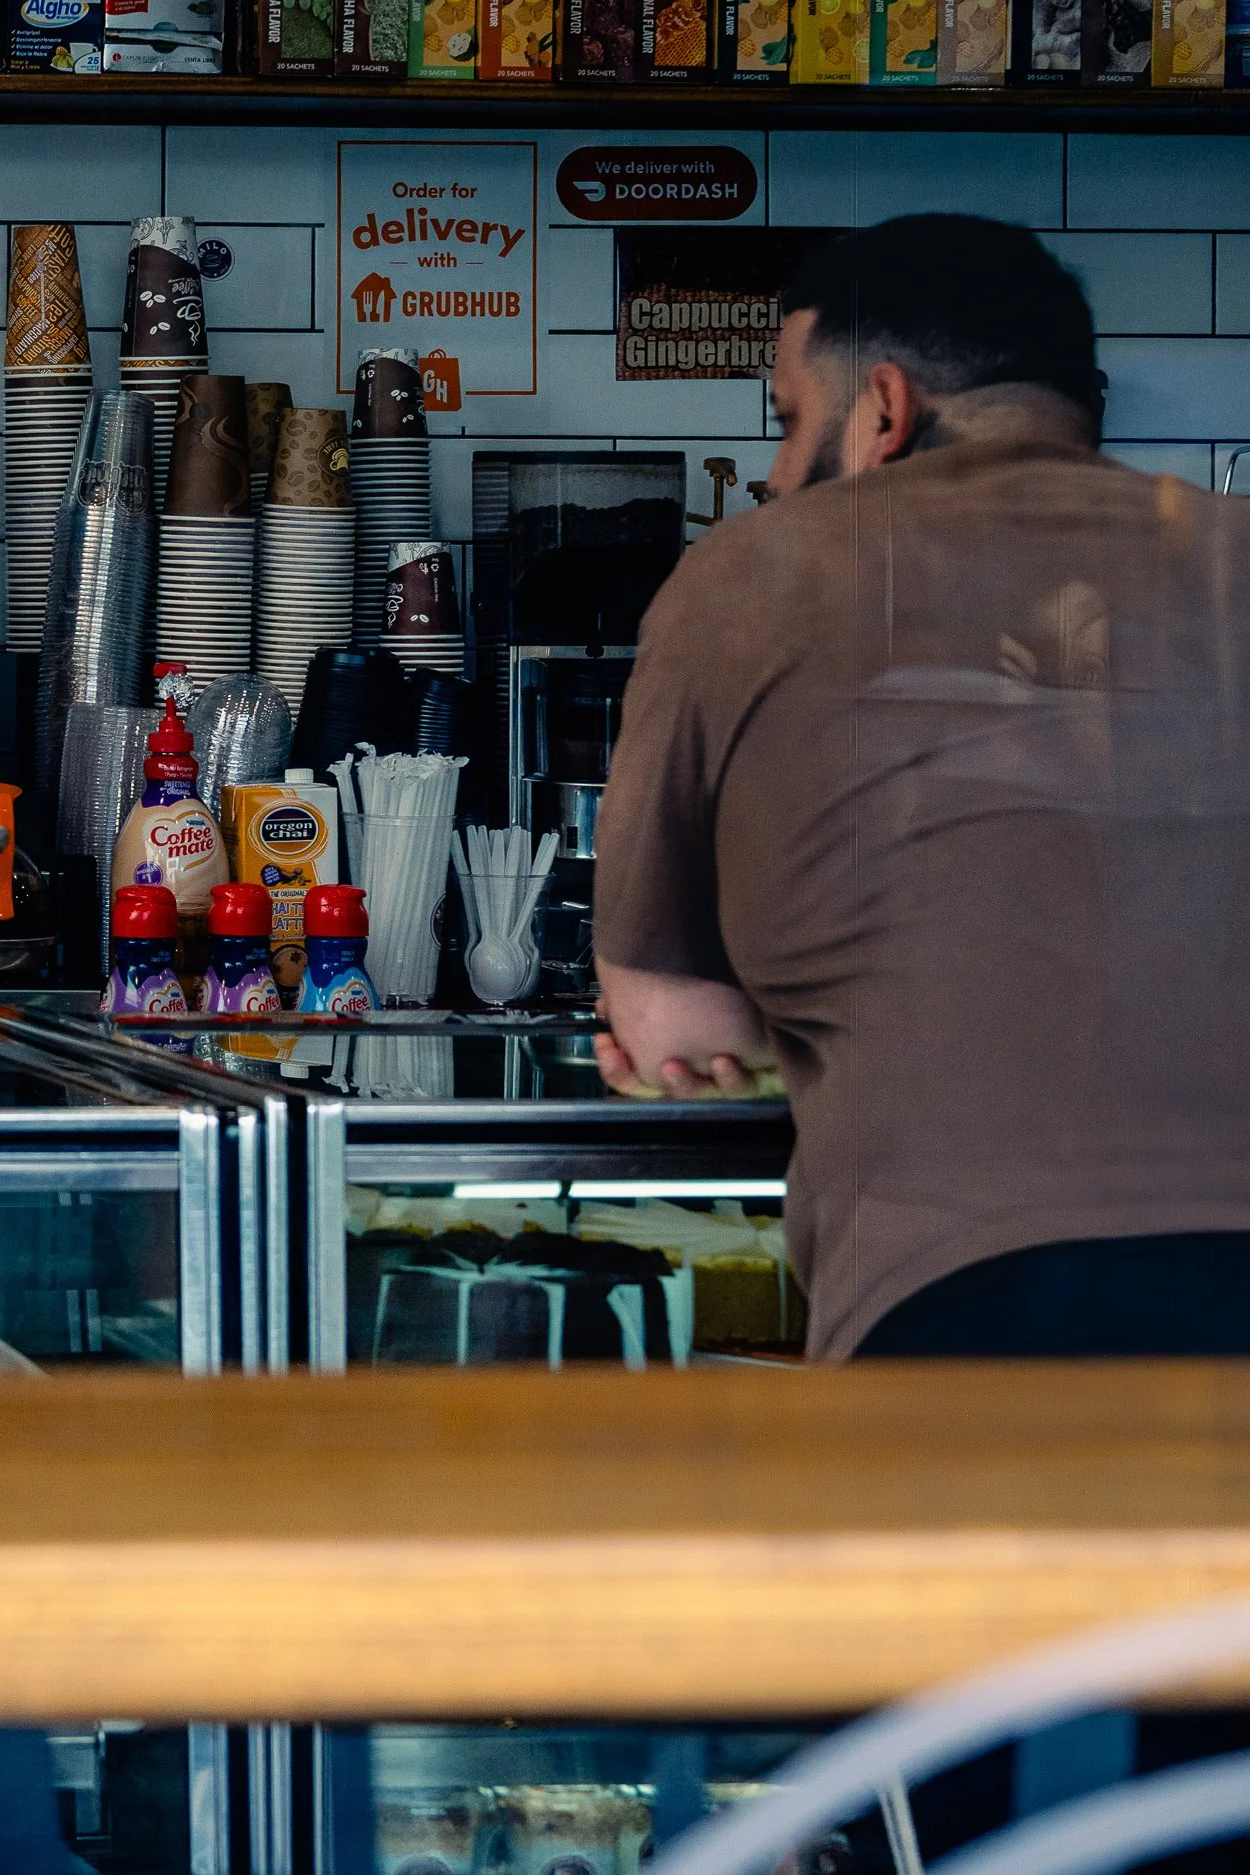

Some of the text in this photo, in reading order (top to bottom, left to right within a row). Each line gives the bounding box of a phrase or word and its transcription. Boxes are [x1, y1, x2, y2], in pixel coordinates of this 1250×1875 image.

[26, 0, 82, 19] Algho
[570, 0, 583, 35] FLAVOR
[1162, 0, 1171, 29] FLAVOR
[268, 9, 281, 43] FLAVOR
[726, 6, 735, 36] FLAVOR
[342, 18, 355, 53] FLAVOR
[642, 20, 654, 54] FLAVOR
[596, 161, 714, 174] We deliver with
[392, 182, 478, 198] Order for
[615, 183, 738, 200] DOORDASH
[352, 207, 526, 258] delivery
[198, 242, 227, 258] MILO
[418, 252, 457, 268] with
[402, 290, 521, 318] GRUBHUB
[630, 297, 783, 332] Cappucci
[625, 334, 778, 370] Gingerbre
[265, 822, 313, 831] oregon
[269, 829, 308, 838] chai
[150, 826, 211, 847] Coffee
[168, 838, 214, 858] mate
[272, 917, 305, 930] LATT
[149, 998, 184, 1012] Coffee
[246, 996, 279, 1012] Coffee
[332, 996, 368, 1012] Coffee
